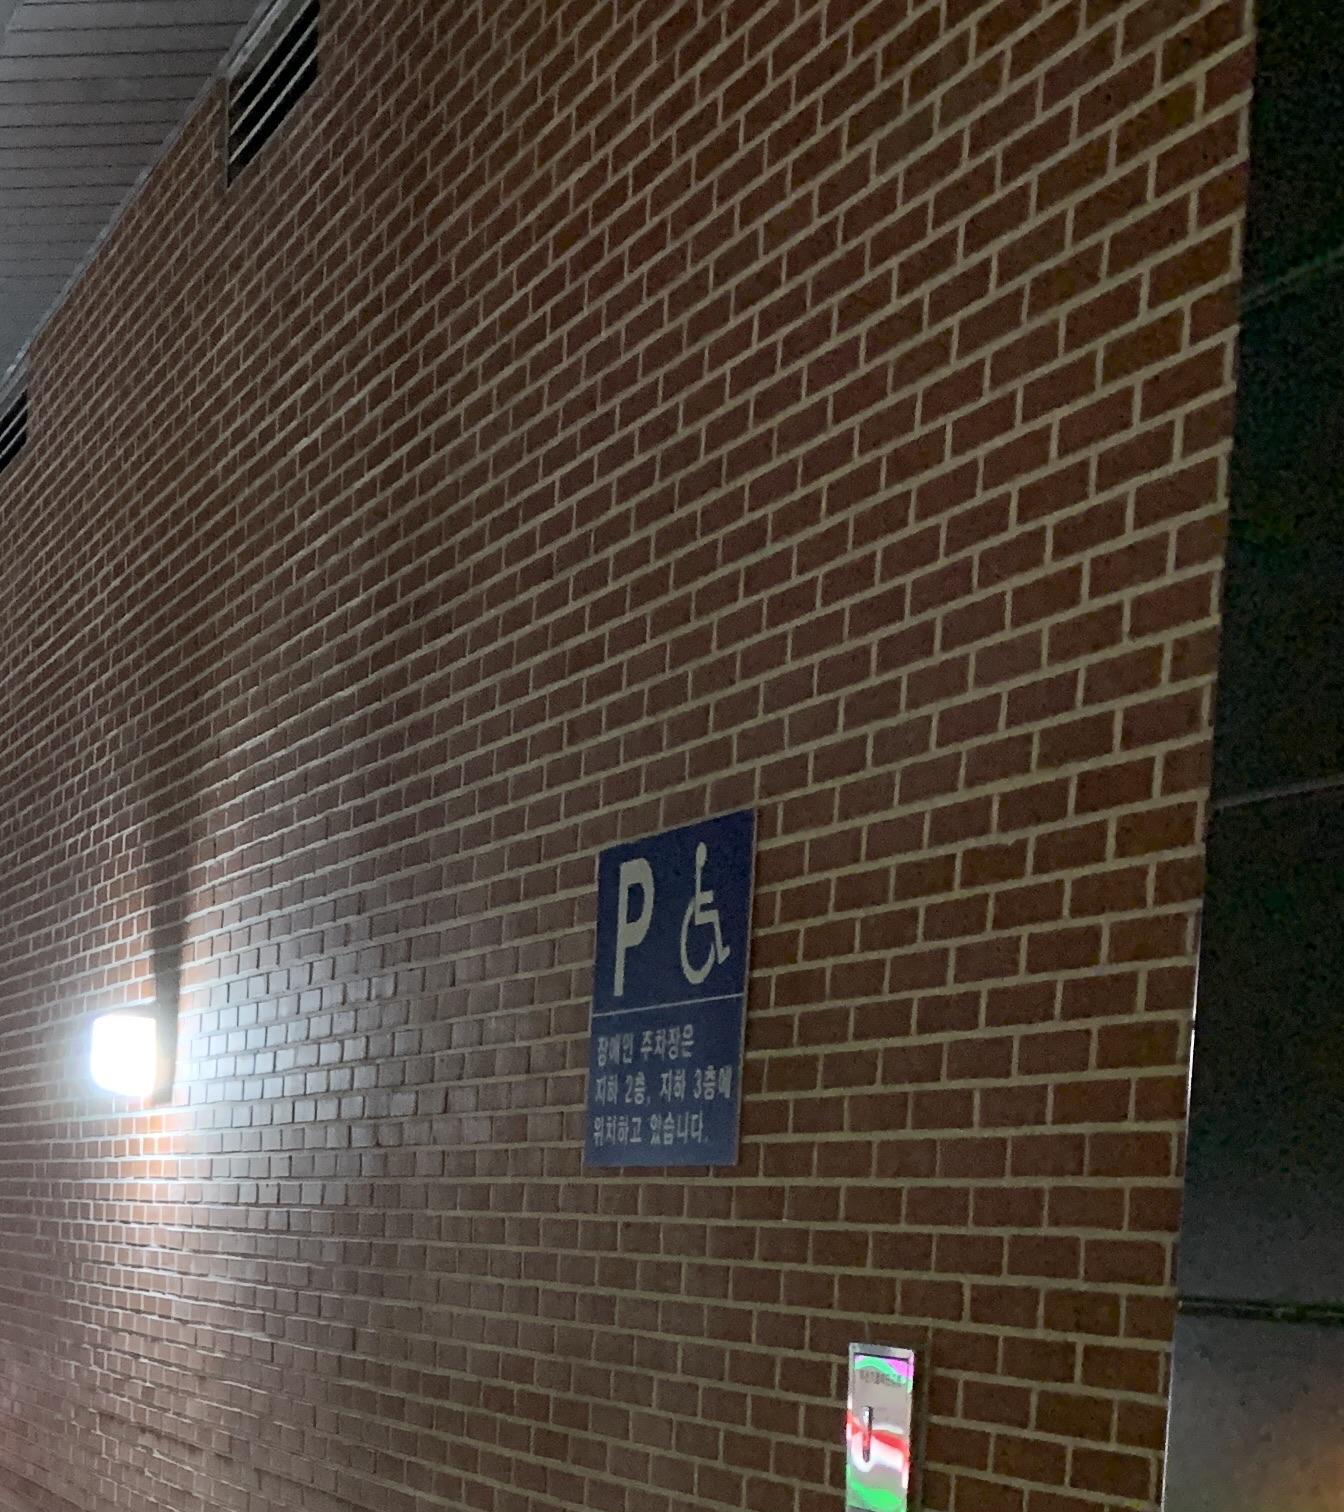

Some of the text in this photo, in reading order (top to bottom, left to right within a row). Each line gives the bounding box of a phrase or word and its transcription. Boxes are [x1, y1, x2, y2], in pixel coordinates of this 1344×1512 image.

[613, 857, 655, 997] P
[597, 1023, 695, 1067] 장애인 주차장은
[595, 1072, 619, 1106] 지하
[660, 1068, 687, 1102] 지하
[692, 1064, 733, 1100] 3층에
[593, 1112, 643, 1147] 위치하고
